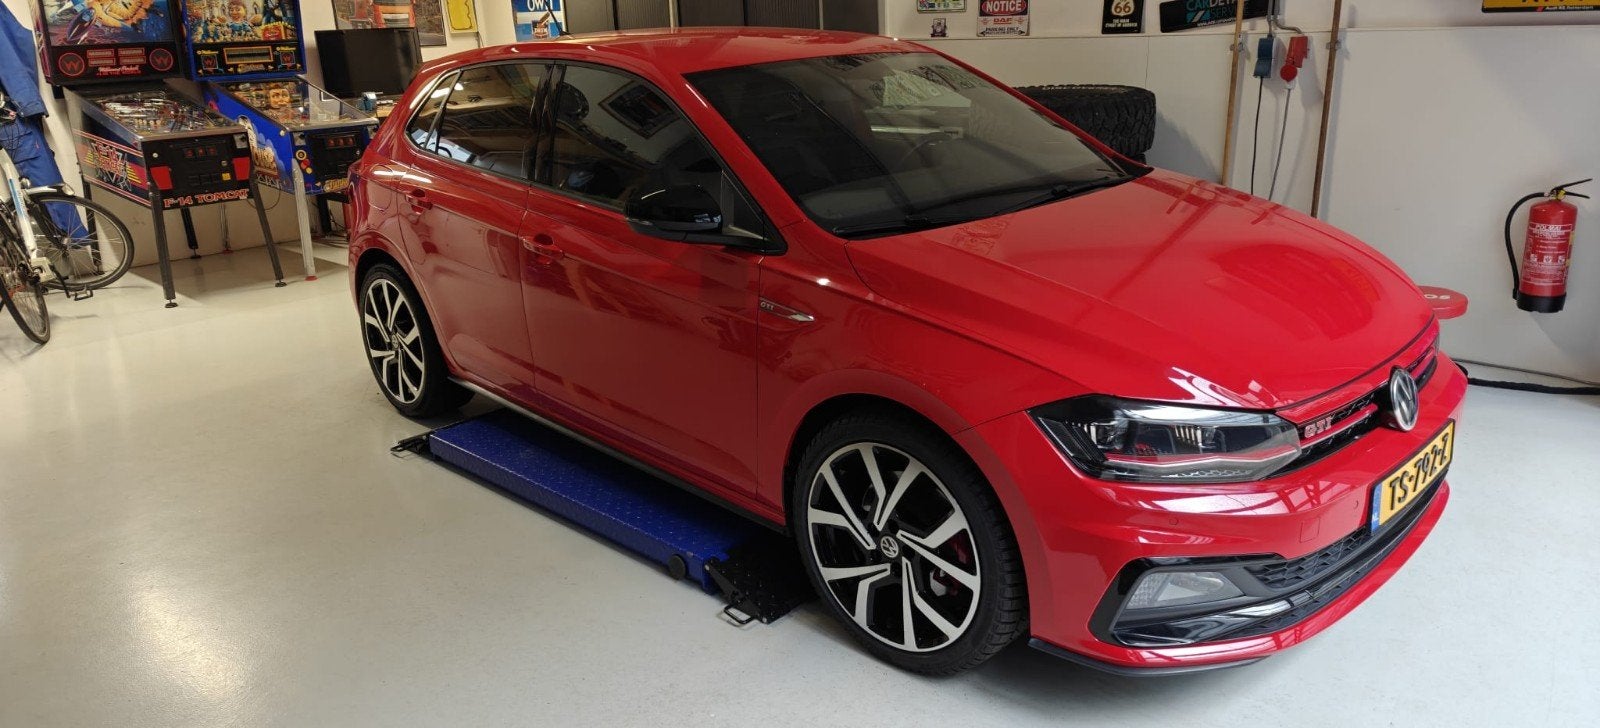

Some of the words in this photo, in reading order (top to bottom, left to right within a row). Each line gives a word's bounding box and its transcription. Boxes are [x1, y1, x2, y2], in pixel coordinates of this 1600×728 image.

[986, 0, 1022, 12] NOTICE
[1114, 2, 1131, 14] 66
[164, 195, 193, 208] F-14
[195, 189, 249, 202] TOMCAT
[760, 301, 774, 311] GTI
[1304, 417, 1332, 438] GTI
[1388, 432, 1450, 511] TS-792-Z
